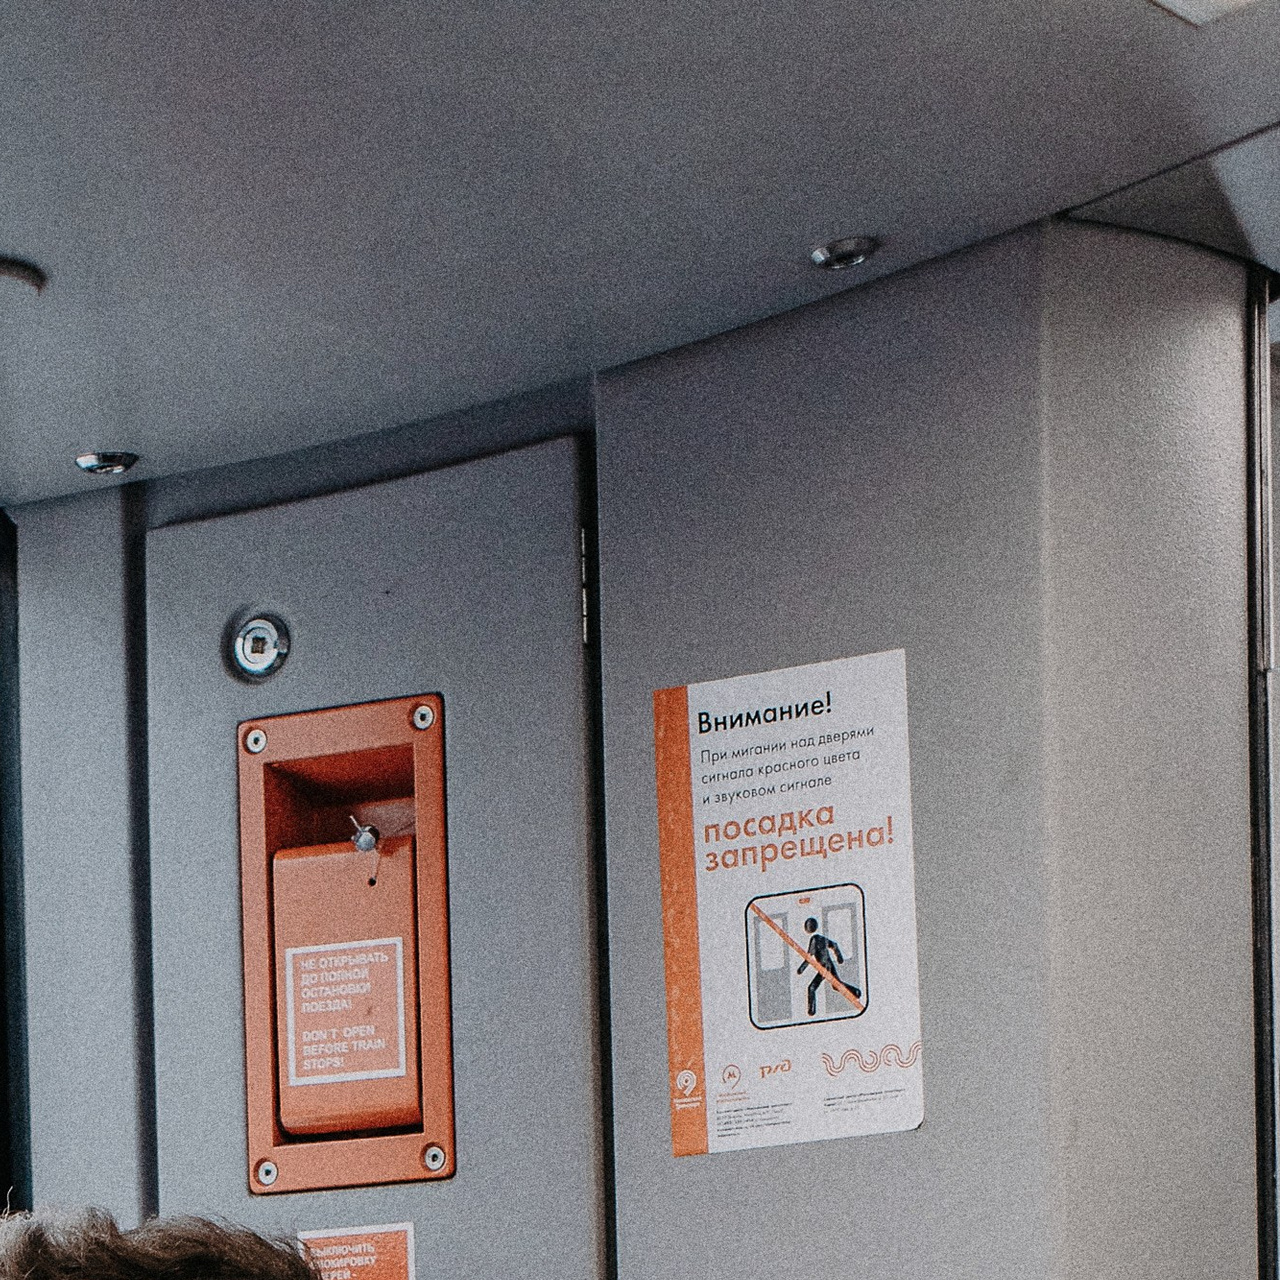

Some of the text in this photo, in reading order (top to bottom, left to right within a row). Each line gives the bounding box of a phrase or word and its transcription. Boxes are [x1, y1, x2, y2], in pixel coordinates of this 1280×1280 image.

[697, 690, 833, 734] Внимание!
[700, 726, 875, 766] При мигании над дверями
[701, 750, 861, 785] сигнала красного цвета
[702, 775, 832, 805] и звуковом сигнале
[703, 805, 835, 843] посадка
[705, 816, 894, 872] запрещена!
[303, 1026, 376, 1041] DON'T OPEN
[303, 1039, 386, 1055] BEFORE TRAIN
[303, 1057, 345, 1069] STOPS!
